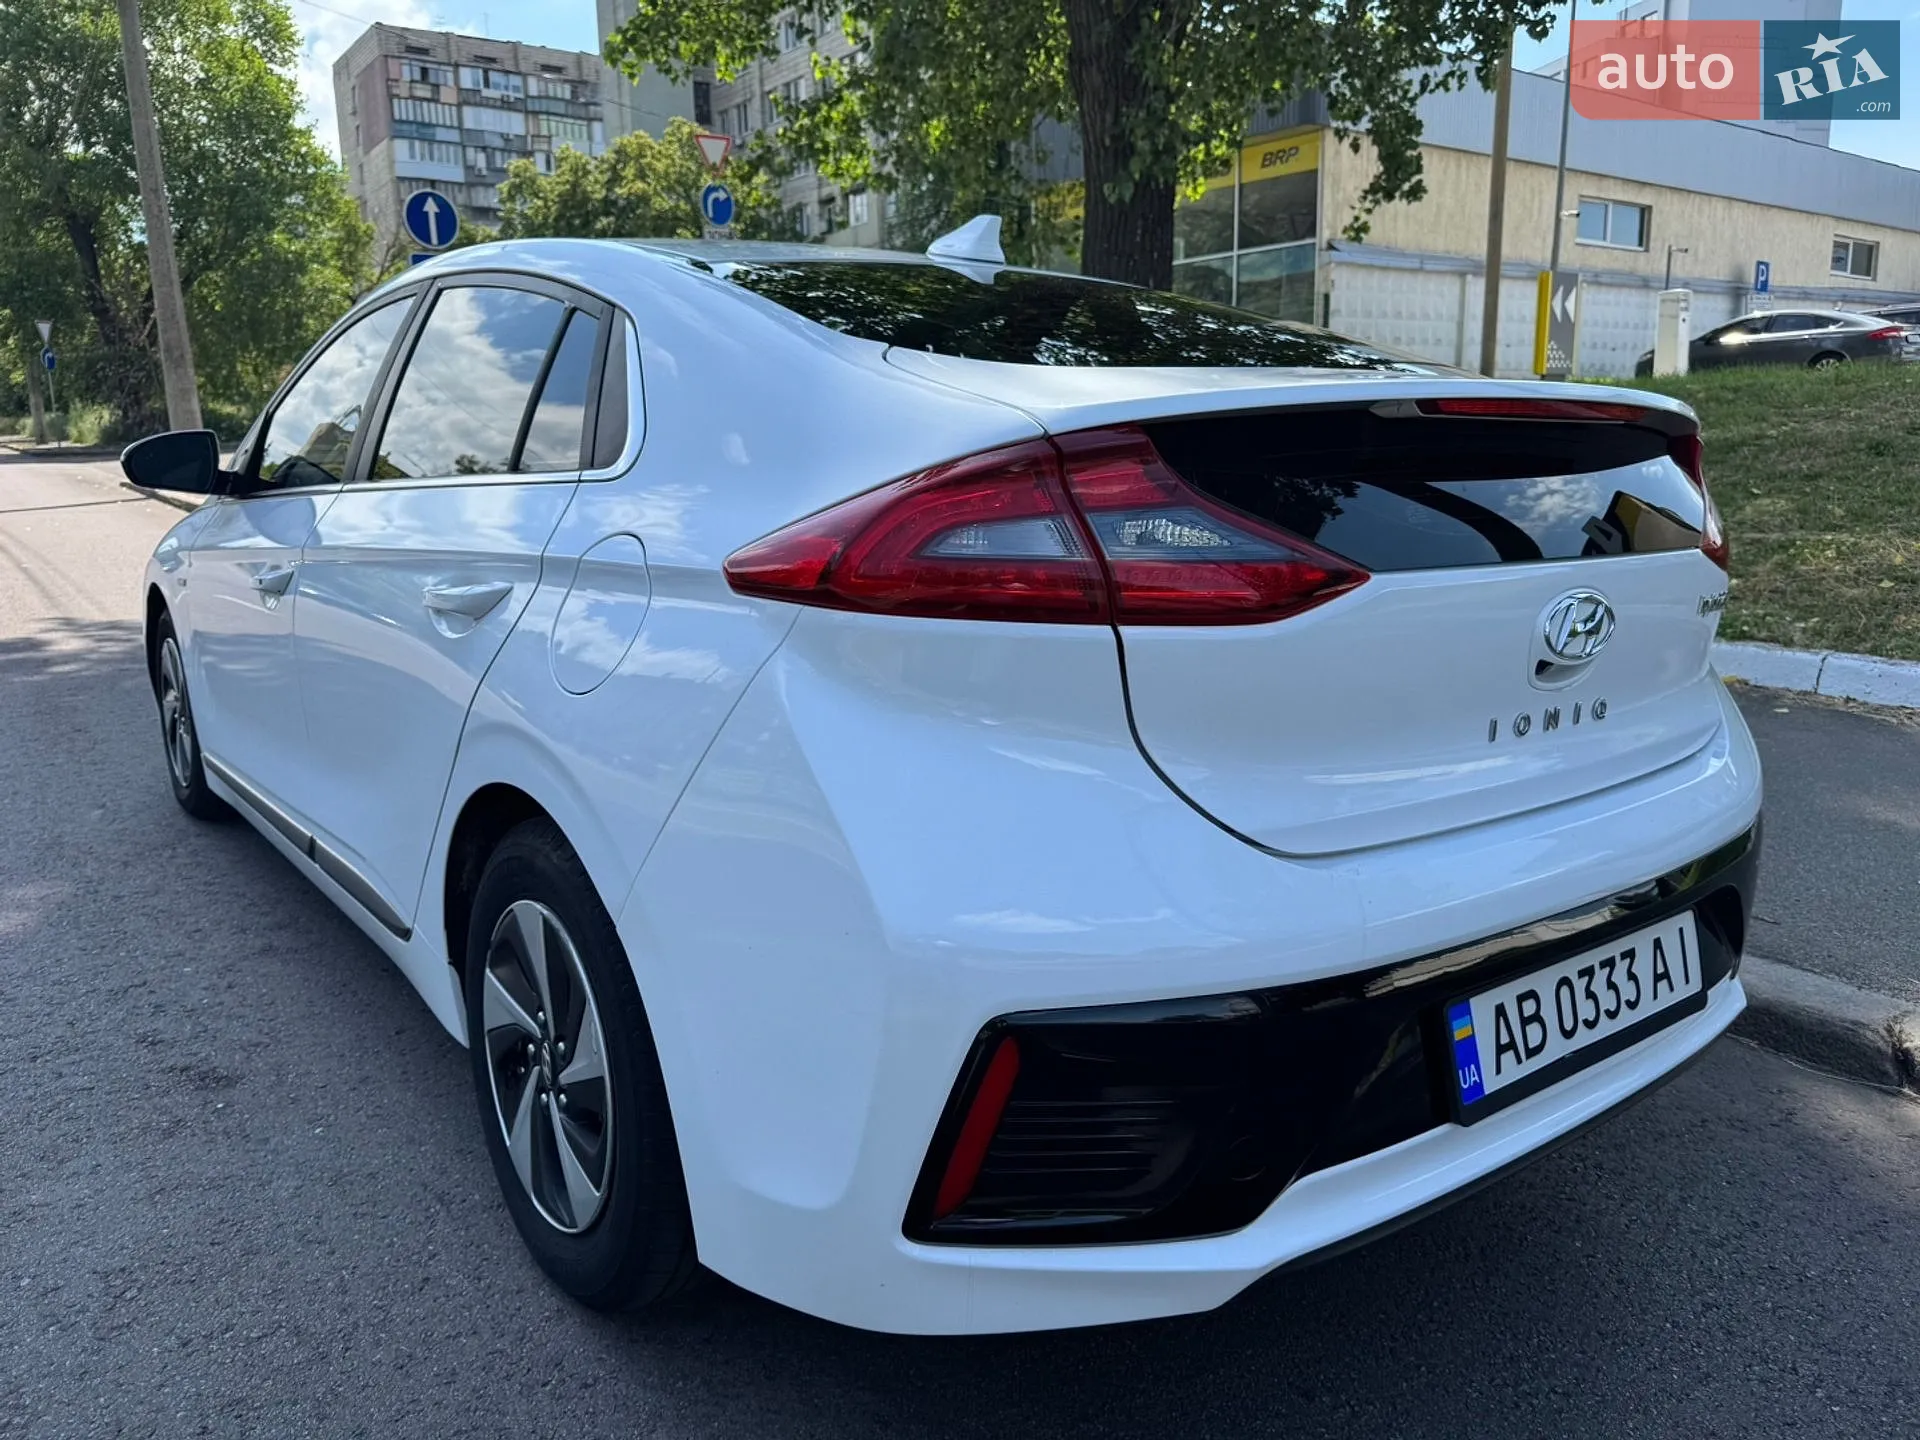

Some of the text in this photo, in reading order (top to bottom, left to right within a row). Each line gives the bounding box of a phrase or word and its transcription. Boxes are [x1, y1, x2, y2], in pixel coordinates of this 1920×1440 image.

[1261, 146, 1299, 169] BRP
[1757, 265, 1767, 289] P
[1488, 697, 1608, 744] IONIQ
[1494, 988, 1548, 1077] AB
[1554, 946, 1642, 1041] 0333
[1458, 1063, 1481, 1090] UA
